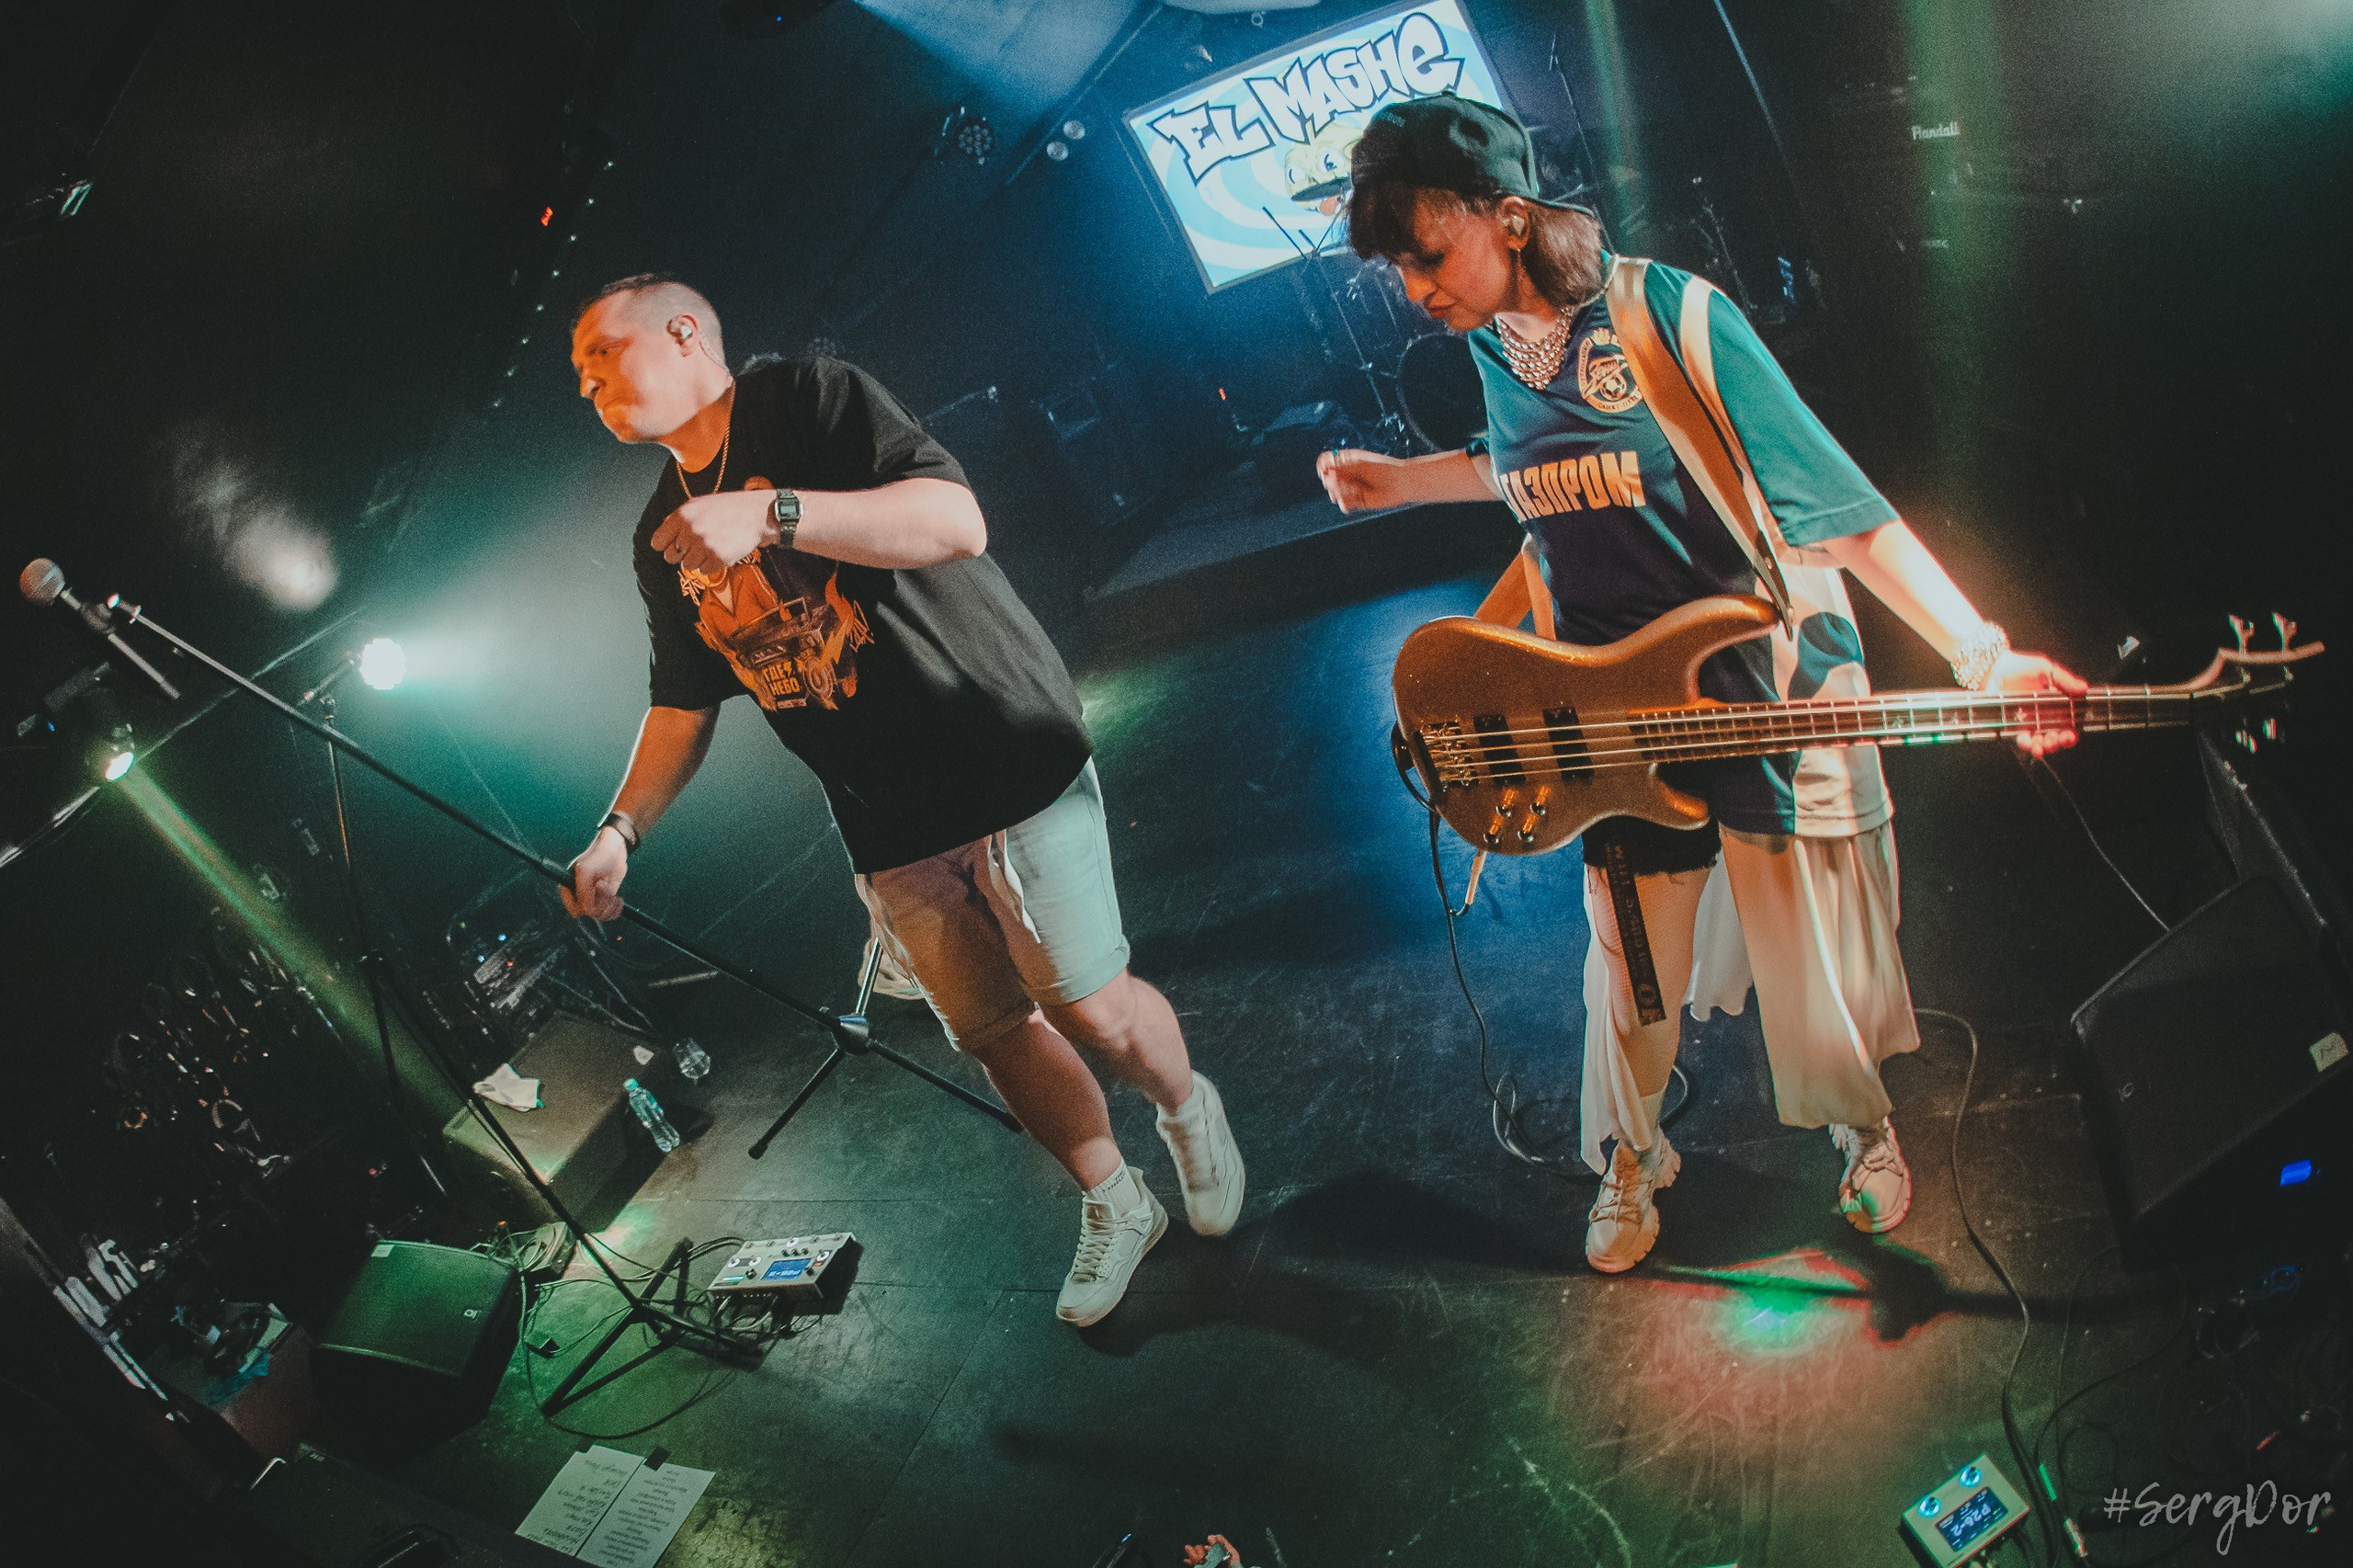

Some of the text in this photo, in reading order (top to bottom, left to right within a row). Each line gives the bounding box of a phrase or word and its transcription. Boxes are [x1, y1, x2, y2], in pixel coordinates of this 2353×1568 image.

[1148, 101, 1274, 187] EL
[1912, 120, 1961, 141] Randall
[1498, 449, 1646, 522] ГАЗПРОМ
[768, 676, 801, 696] НЕБО
